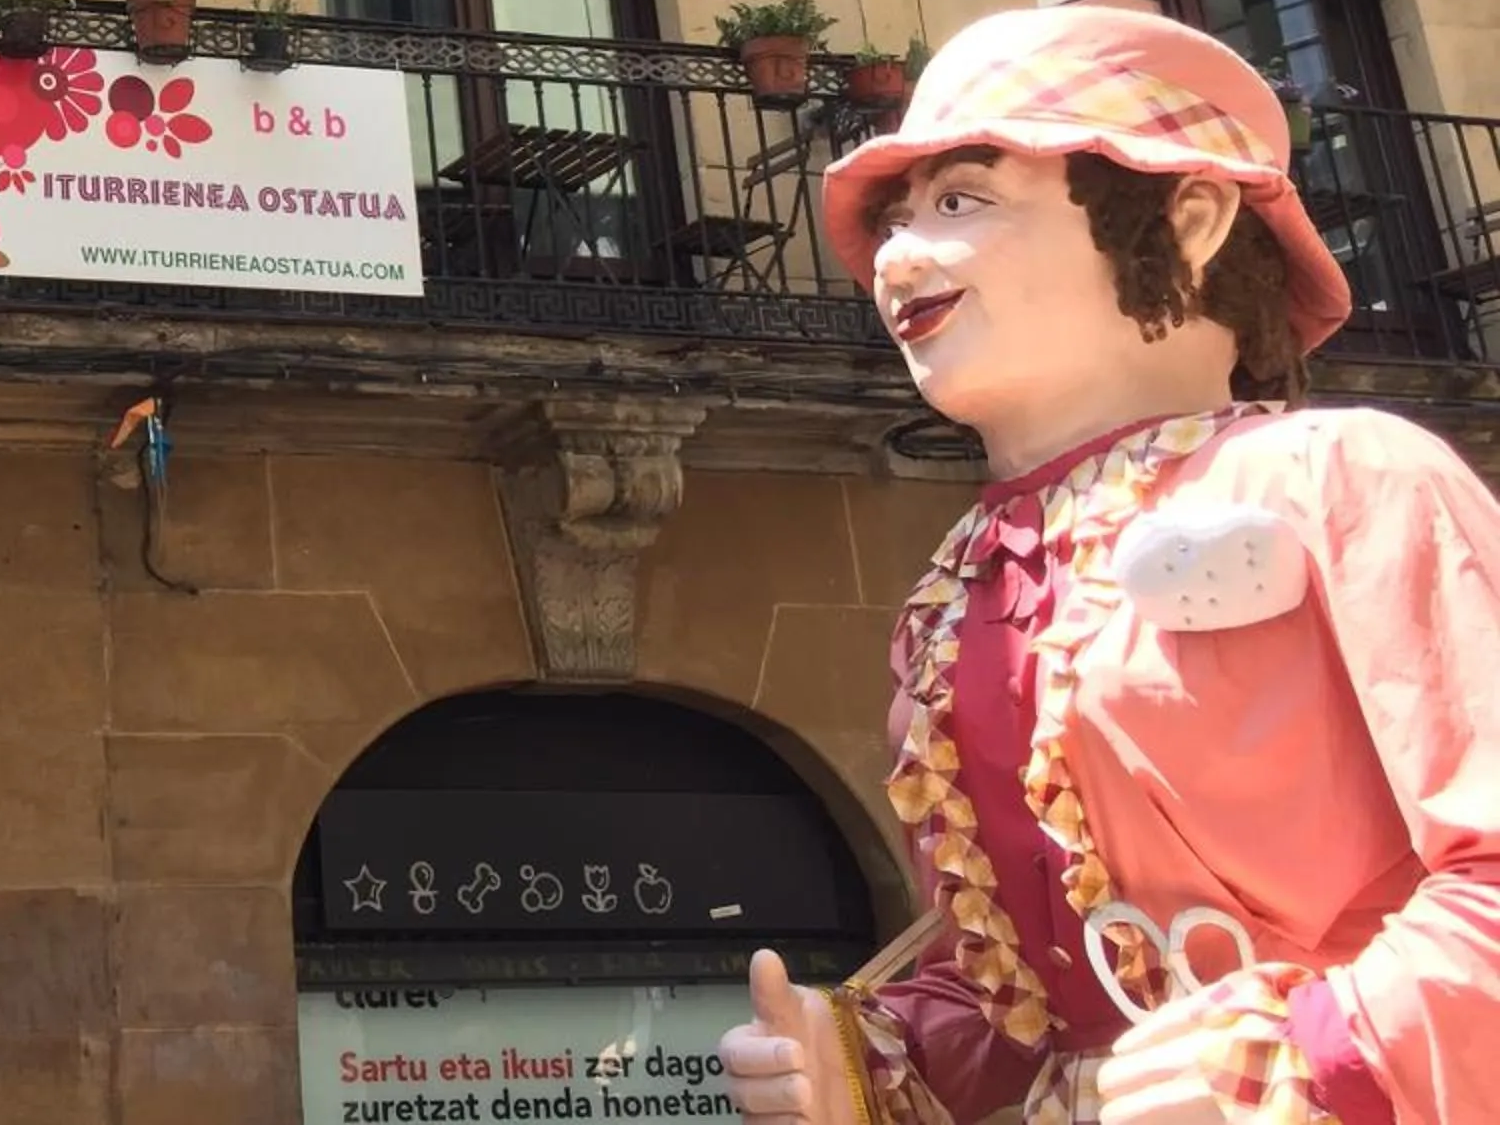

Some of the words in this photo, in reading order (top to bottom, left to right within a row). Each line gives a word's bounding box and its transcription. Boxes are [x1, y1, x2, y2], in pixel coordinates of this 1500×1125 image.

[253, 103, 276, 134] b
[287, 105, 312, 136] &
[324, 107, 347, 139] b
[42, 172, 250, 212] ITURRIENEA
[258, 186, 407, 221] OSTATUA
[80, 245, 405, 281] WWW.ITURRIENEAOSTATUA.COM
[340, 1051, 428, 1083] Sartu
[439, 1052, 491, 1081] eta
[501, 1047, 574, 1079] ikusi
[585, 1055, 634, 1078] zer
[645, 1045, 725, 1085] dago
[343, 1092, 480, 1123] zuretzat
[491, 1086, 593, 1119] denda
[602, 1085, 742, 1118] honetan.
